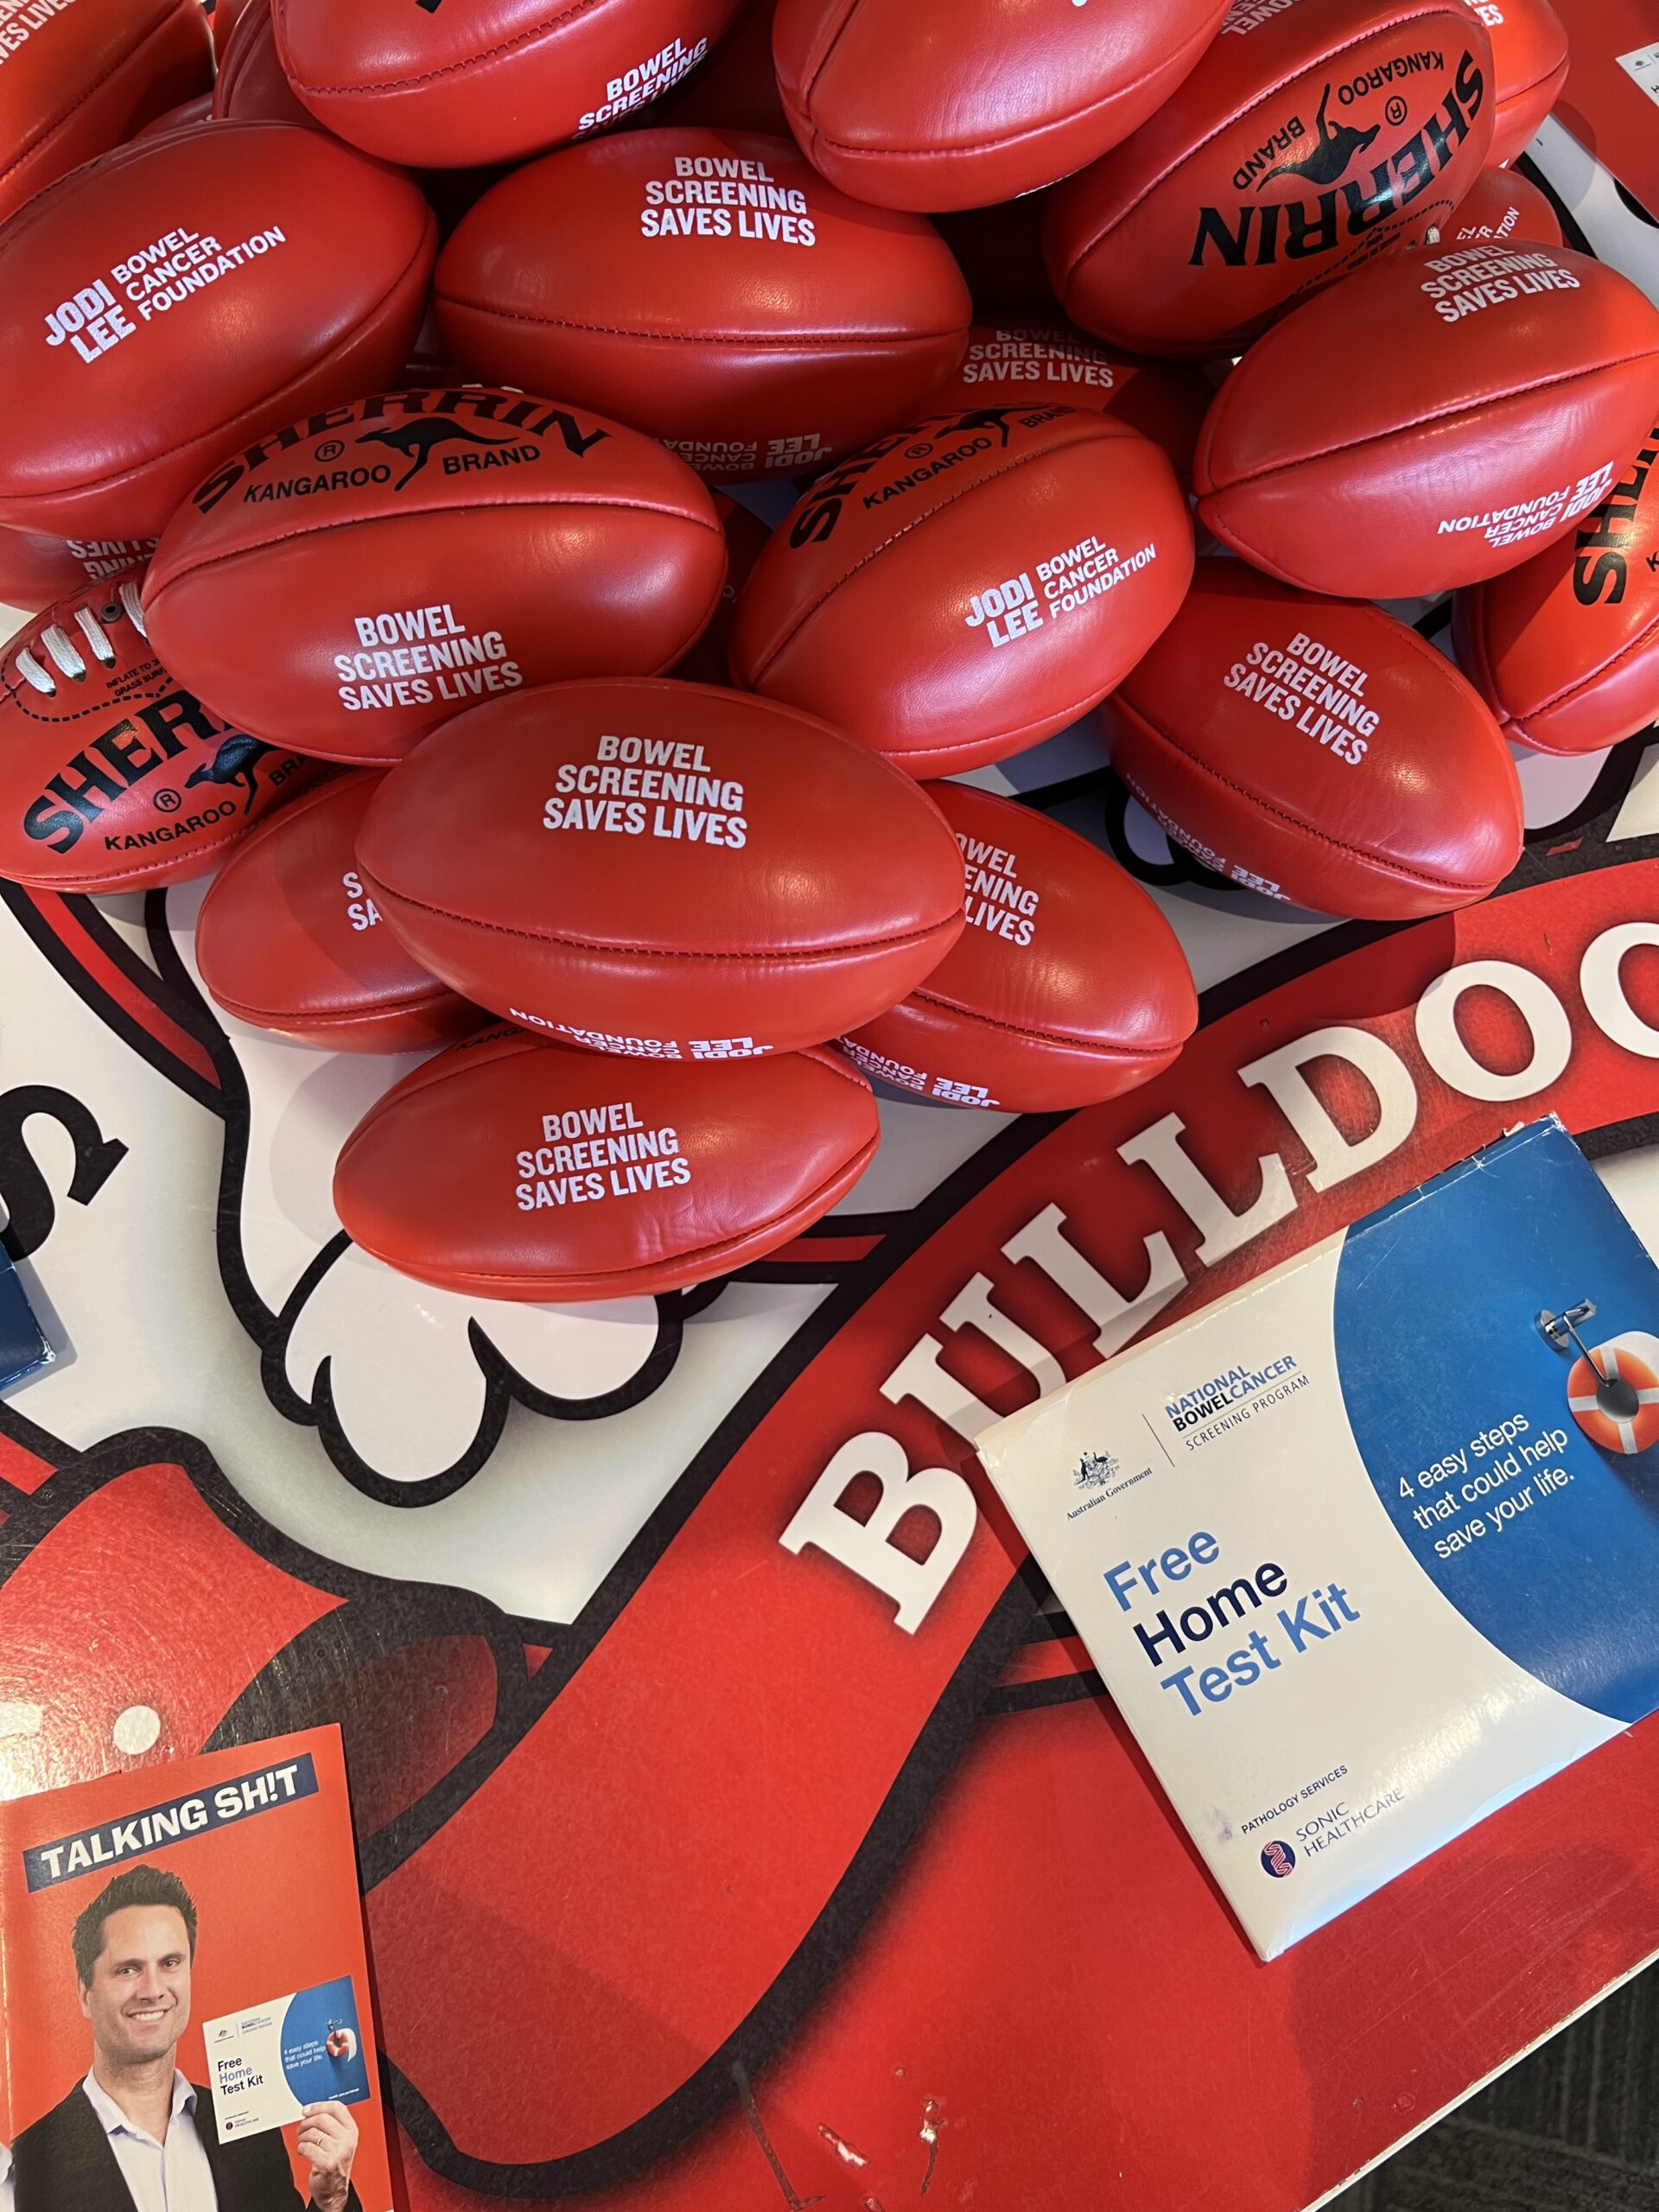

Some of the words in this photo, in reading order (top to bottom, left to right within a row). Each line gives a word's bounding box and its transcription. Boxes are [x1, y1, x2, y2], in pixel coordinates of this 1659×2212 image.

[578, 36, 708, 130] SCREENING
[606, 37, 687, 101] BOWEL
[1338, 49, 1445, 105] KANGAROO
[675, 156, 774, 182] BOWEL
[1187, 49, 1484, 267] SHERRIN
[1232, 116, 1306, 190] BRAND
[645, 181, 807, 214] SCREENING
[641, 209, 732, 238] SAVES
[738, 213, 816, 247] LIVES
[111, 227, 199, 284] BOWEL
[125, 236, 223, 302] CANCER
[137, 226, 287, 321] FOUNDATION
[1421, 253, 1558, 298] SCREENING
[1424, 245, 1516, 273] BOWEL
[45, 278, 117, 346] JODI
[1434, 279, 1518, 323] SAVES
[1512, 269, 1580, 295] LIVES
[70, 304, 137, 364] LEE
[969, 342, 1109, 365] SCREENING
[963, 361, 1040, 384] SAVES
[1046, 364, 1114, 388] LIVES
[192, 391, 613, 515] SHERRIN
[655, 438, 758, 452] FOUNDA
[678, 452, 756, 462] CANCE
[764, 447, 832, 468] JODI
[766, 433, 821, 455] LEE
[862, 437, 993, 510] KANGAROO
[1017, 406, 1077, 429] BRAND
[243, 465, 391, 503] KANGAROO
[442, 444, 541, 474] BRAND
[1570, 461, 1614, 501] LEE
[1437, 486, 1571, 535] FOUNDATION
[1484, 503, 1565, 539] CANCER
[1560, 478, 1612, 523] JODI
[1488, 518, 1556, 549] BOWEL
[1035, 536, 1106, 582] BOWEL
[1043, 548, 1119, 599] CANCER
[1050, 543, 1157, 619] FOUNDATION
[964, 572, 1035, 628] JODI
[354, 604, 465, 647] BOWEL
[986, 603, 1044, 649] LEE
[139, 663, 152, 675] TO
[334, 632, 506, 682] SCREENING
[1287, 632, 1369, 697] BOWEL
[114, 679, 143, 696] GRASS
[142, 669, 168, 684] SURF
[339, 679, 433, 710] SAVES
[441, 662, 523, 701] LIVES
[1245, 642, 1380, 738] SCREENING
[1224, 662, 1302, 721] SAVES
[1296, 713, 1369, 766] LIVES
[23, 690, 243, 855] SHER
[596, 735, 710, 772] BOWEL
[555, 764, 743, 812] SCREENING
[105, 800, 236, 850] KANGAROO
[543, 799, 647, 835] SAVES
[653, 809, 747, 849] LIVES
[1230, 873, 1291, 901] JODI
[1231, 864, 1280, 893] LEE
[509, 1007, 677, 1049] FOUNDATION
[689, 1036, 753, 1052] LEE
[691, 1045, 773, 1059] JODI
[931, 1087, 1001, 1107] JODI
[935, 1077, 988, 1098] LEE
[542, 1102, 644, 1142] BOWEL
[516, 1128, 678, 1179] SCREENING
[515, 1173, 606, 1211] SAVES
[610, 1157, 691, 1196] LIVES
[1165, 1365, 1250, 1418] NATIONAL
[1185, 1408, 1251, 1452] SCREENING
[1253, 1374, 1311, 1414] PROGRAM
[1398, 1476, 1414, 1498] 4
[1416, 1448, 1468, 1489] easy
[1470, 1413, 1530, 1457] steps
[1413, 1494, 1461, 1530] that
[1461, 1452, 1520, 1503] could
[1518, 1427, 1569, 1466] help
[1065, 1491, 1107, 1521] Australian
[1105, 1467, 1153, 1499] Government
[1433, 1519, 1487, 1559] save
[1486, 1486, 1535, 1533] your
[1533, 1468, 1575, 1497] life.
[1103, 1530, 1220, 1613] Free
[1133, 1562, 1288, 1668] Home
[1160, 1630, 1282, 1717] Test
[1276, 1582, 1361, 1654] Kit
[41, 1799, 209, 1879] TALKING
[213, 1764, 301, 1820] SH!T
[1241, 1792, 1300, 1834] PATHOLOGY
[1300, 1765, 1348, 1799] SERVICES
[1295, 1802, 1351, 1842] SONIC
[1304, 1788, 1405, 1858] HEALTHCARE
[218, 2056, 243, 2072] Free
[219, 2066, 252, 2083] Home
[220, 2081, 245, 2095] Test
[247, 2074, 264, 2088] Kit
